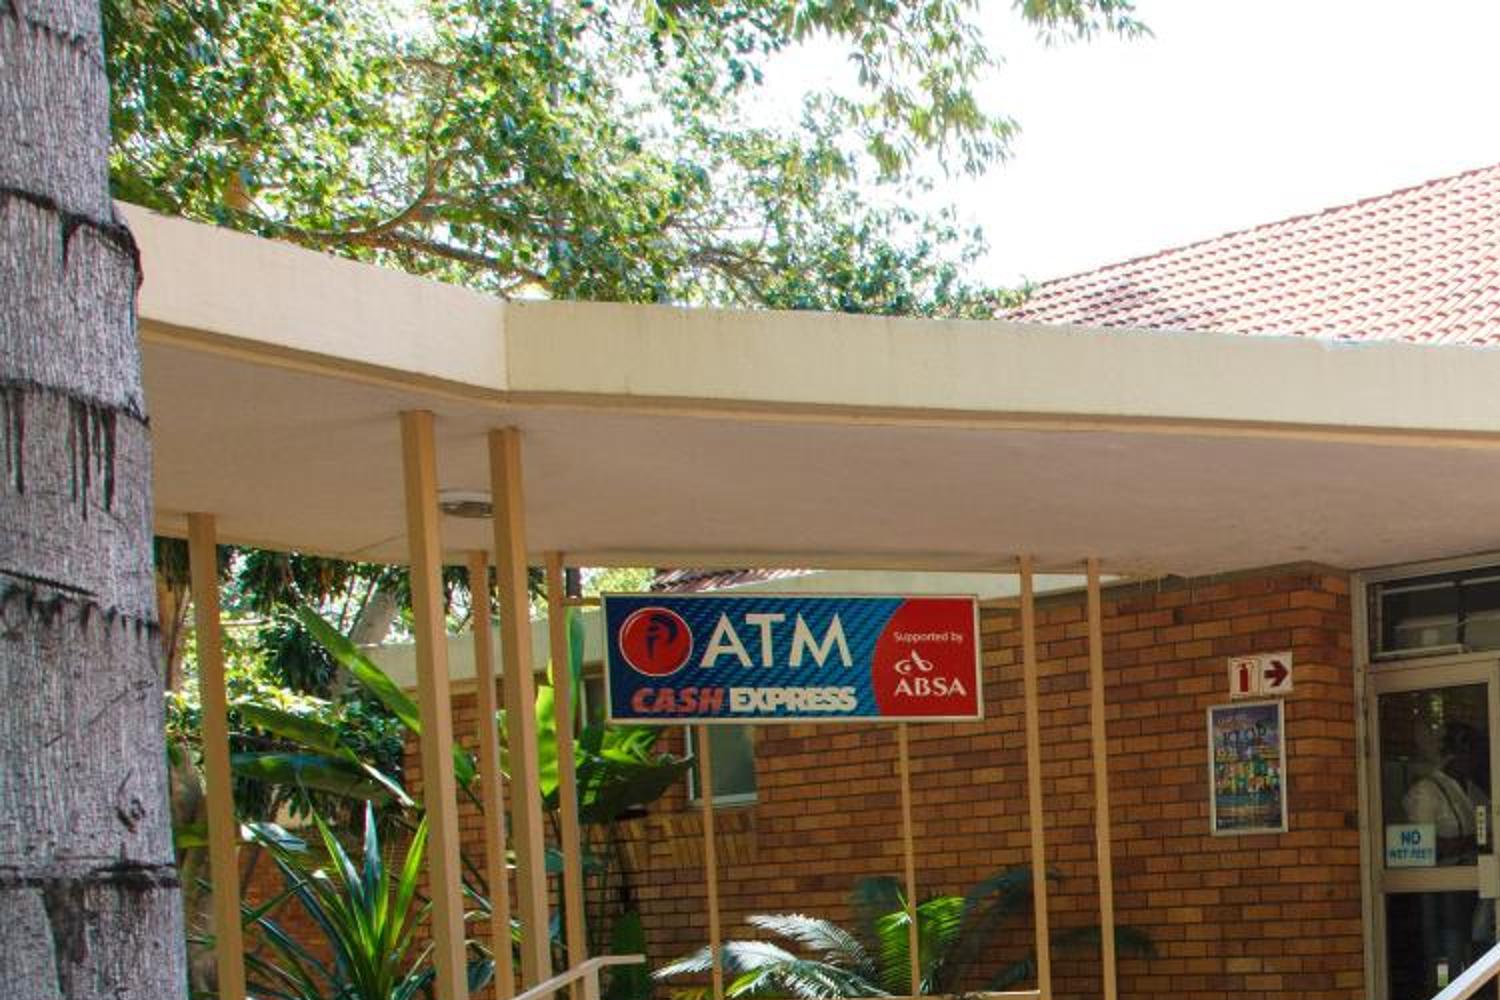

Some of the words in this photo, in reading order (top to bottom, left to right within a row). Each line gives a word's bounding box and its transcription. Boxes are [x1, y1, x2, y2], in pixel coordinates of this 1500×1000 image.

[700, 612, 853, 668] ATM
[893, 632, 949, 643] Supported
[951, 631, 963, 643] by
[894, 677, 967, 697] ABSA
[631, 687, 725, 713] CASH
[729, 686, 857, 712] EXPRESS
[1401, 830, 1421, 845] NO
